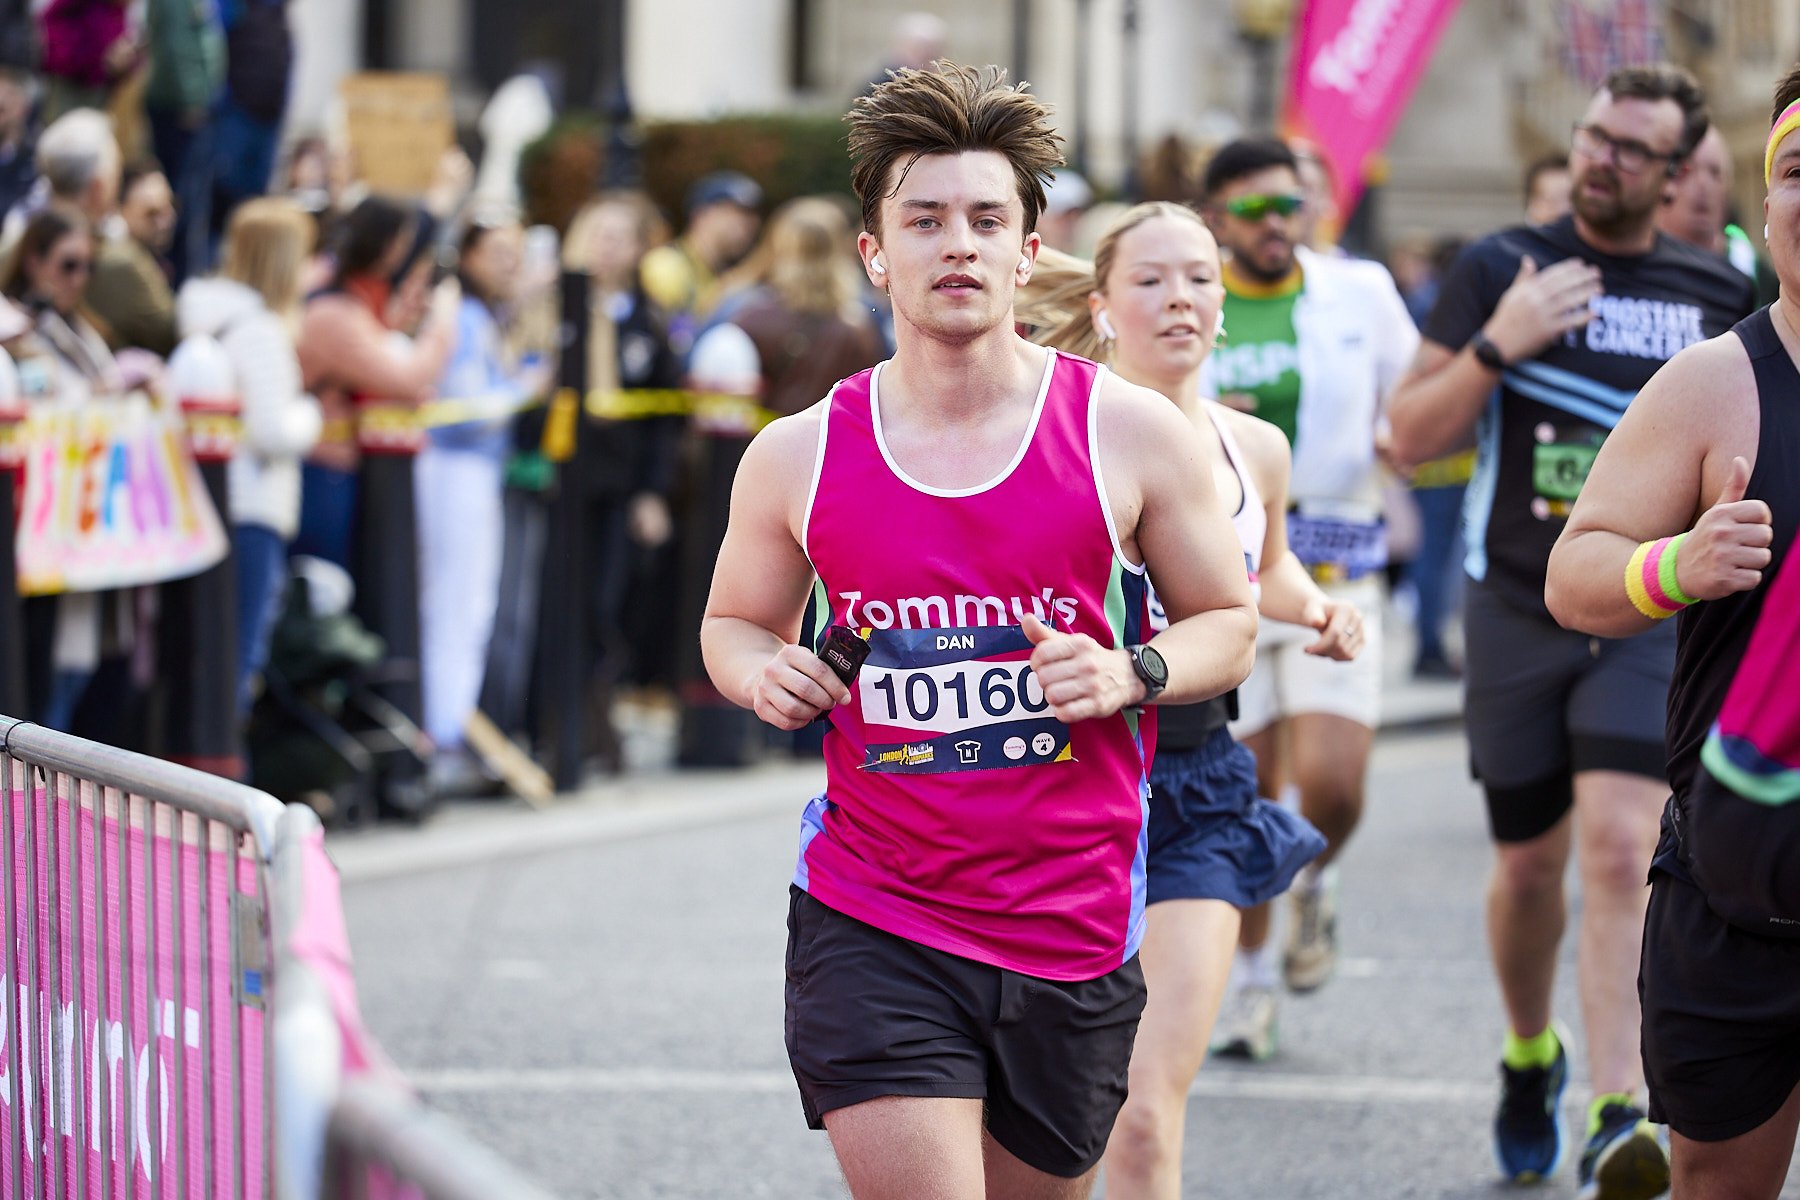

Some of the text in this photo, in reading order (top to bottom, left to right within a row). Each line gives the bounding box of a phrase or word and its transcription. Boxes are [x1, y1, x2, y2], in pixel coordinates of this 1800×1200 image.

[1589, 295, 1703, 336] PROSTATE
[838, 587, 1079, 630] Tommy's
[936, 635, 975, 650] DAN
[873, 665, 1050, 722] 10160
[965, 748, 972, 758] M
[1040, 743, 1048, 752] 4
[879, 750, 903, 762] LONDON
